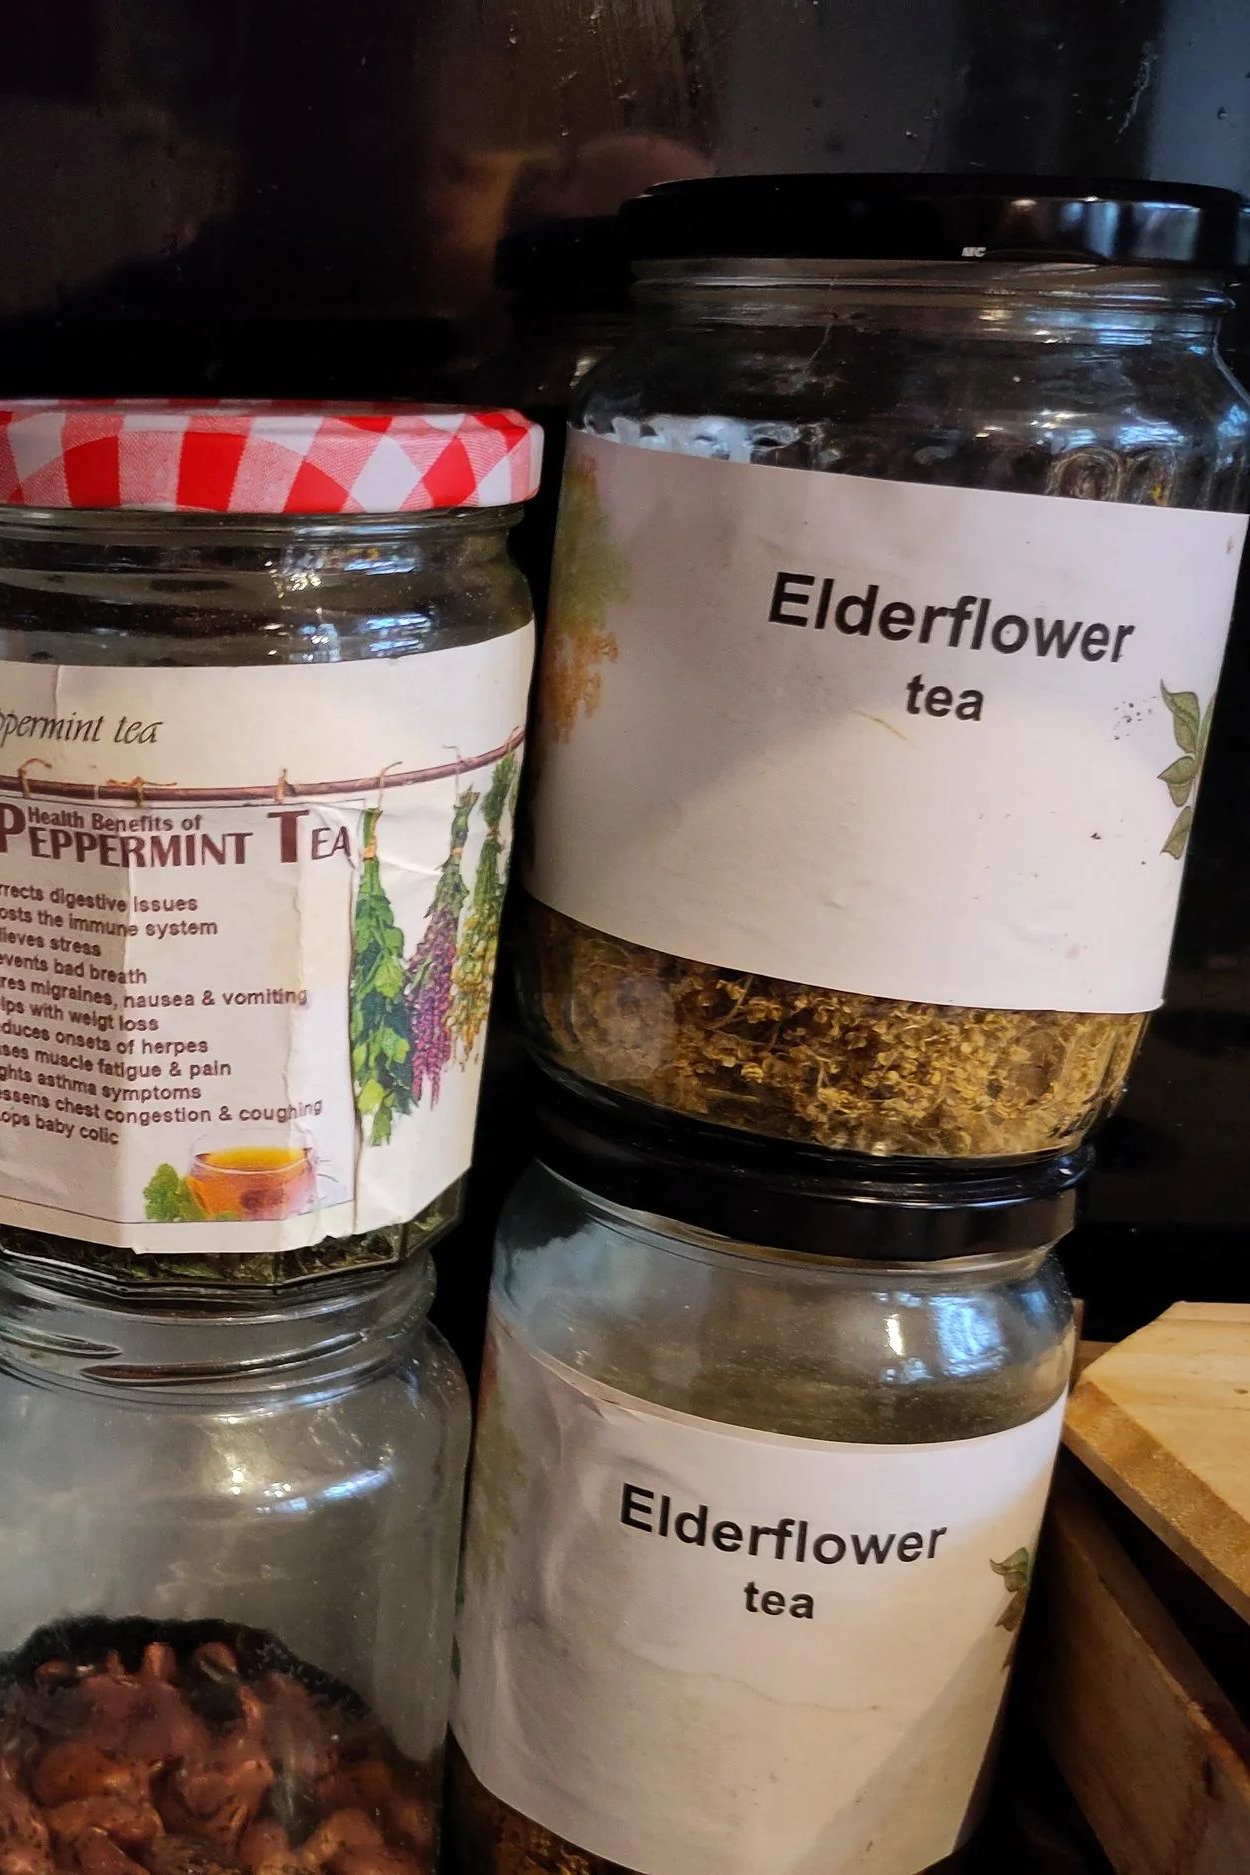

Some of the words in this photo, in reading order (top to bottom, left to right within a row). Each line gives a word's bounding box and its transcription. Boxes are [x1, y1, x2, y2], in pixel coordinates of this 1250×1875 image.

[769, 572, 1135, 662] Elderflower
[906, 674, 984, 722] tea
[113, 714, 164, 745] tea
[27, 806, 84, 829] Health
[92, 813, 174, 832] Benefits
[182, 815, 202, 830] of
[267, 810, 355, 868] TEA
[50, 888, 127, 912] digestive
[134, 896, 198, 913] issues
[37, 910, 63, 927] the
[69, 913, 138, 937] immune
[145, 920, 218, 939] system
[50, 937, 101, 956] stress
[54, 958, 85, 977] bad
[89, 963, 147, 984] breath
[31, 980, 118, 1006] migraines,
[123, 994, 195, 1008] nausea
[201, 990, 215, 1006] &
[222, 988, 308, 1009] vomiting
[30, 1003, 63, 1021] with
[69, 1010, 114, 1031] weigt
[119, 1016, 159, 1032] loss
[55, 1031, 111, 1051] onsets
[116, 1039, 134, 1054] of
[141, 1039, 209, 1056] herpes
[35, 1050, 93, 1072] muscle
[98, 1058, 162, 1081] fatigue
[169, 1062, 182, 1077] &
[189, 1060, 231, 1079] pain
[38, 1073, 97, 1096] asthma
[101, 1086, 202, 1103] symptoms
[55, 1097, 100, 1119] chest
[105, 1105, 211, 1126] congestion
[219, 1106, 233, 1121] &
[239, 1099, 323, 1123] coughing
[35, 1114, 75, 1139] baby
[79, 1126, 119, 1145] colic
[621, 1482, 947, 1565] Elderflower
[744, 1581, 814, 1619] tea
